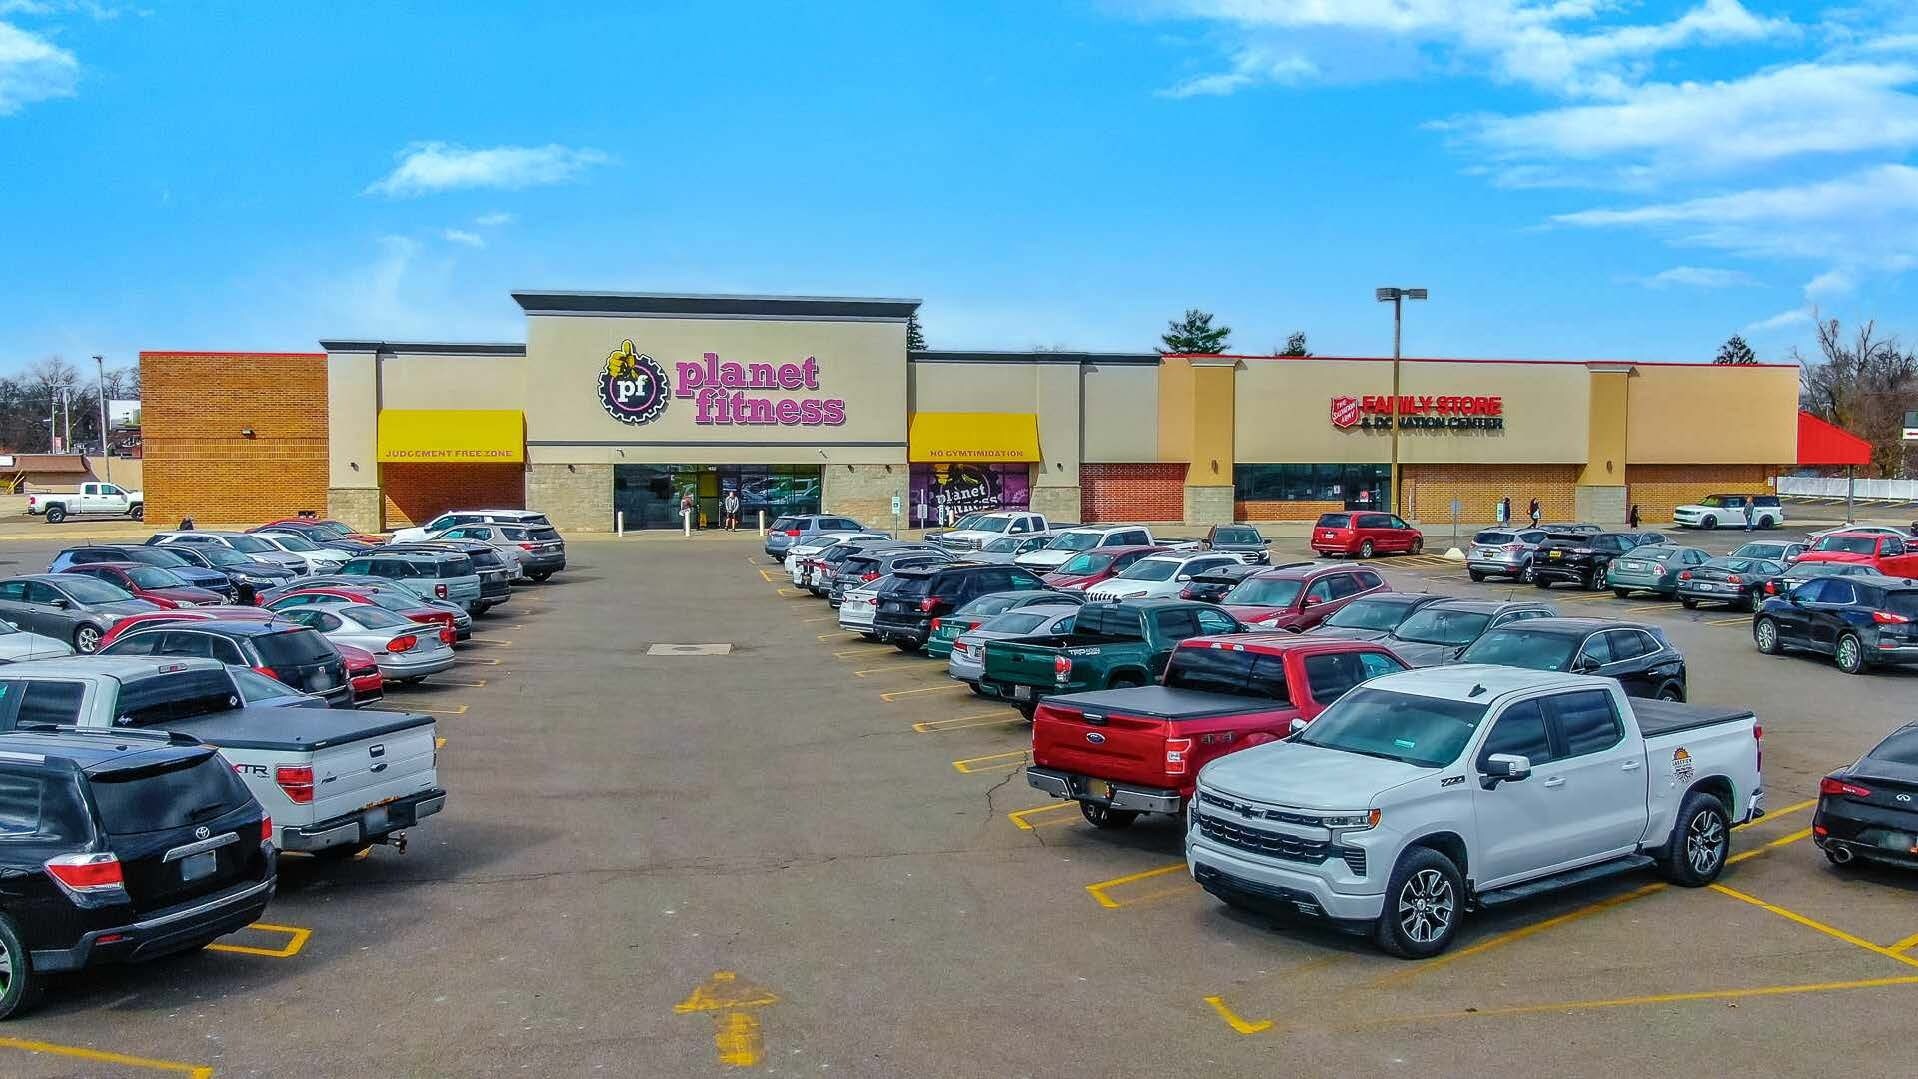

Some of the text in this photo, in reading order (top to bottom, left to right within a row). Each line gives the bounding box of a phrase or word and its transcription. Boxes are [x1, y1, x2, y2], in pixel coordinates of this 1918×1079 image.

[675, 352, 819, 397] planet
[617, 374, 648, 403] pf
[695, 388, 846, 424] fitness
[1436, 396, 1503, 416] STORE
[385, 450, 453, 458] JUDGEMENT
[936, 484, 987, 505] planet
